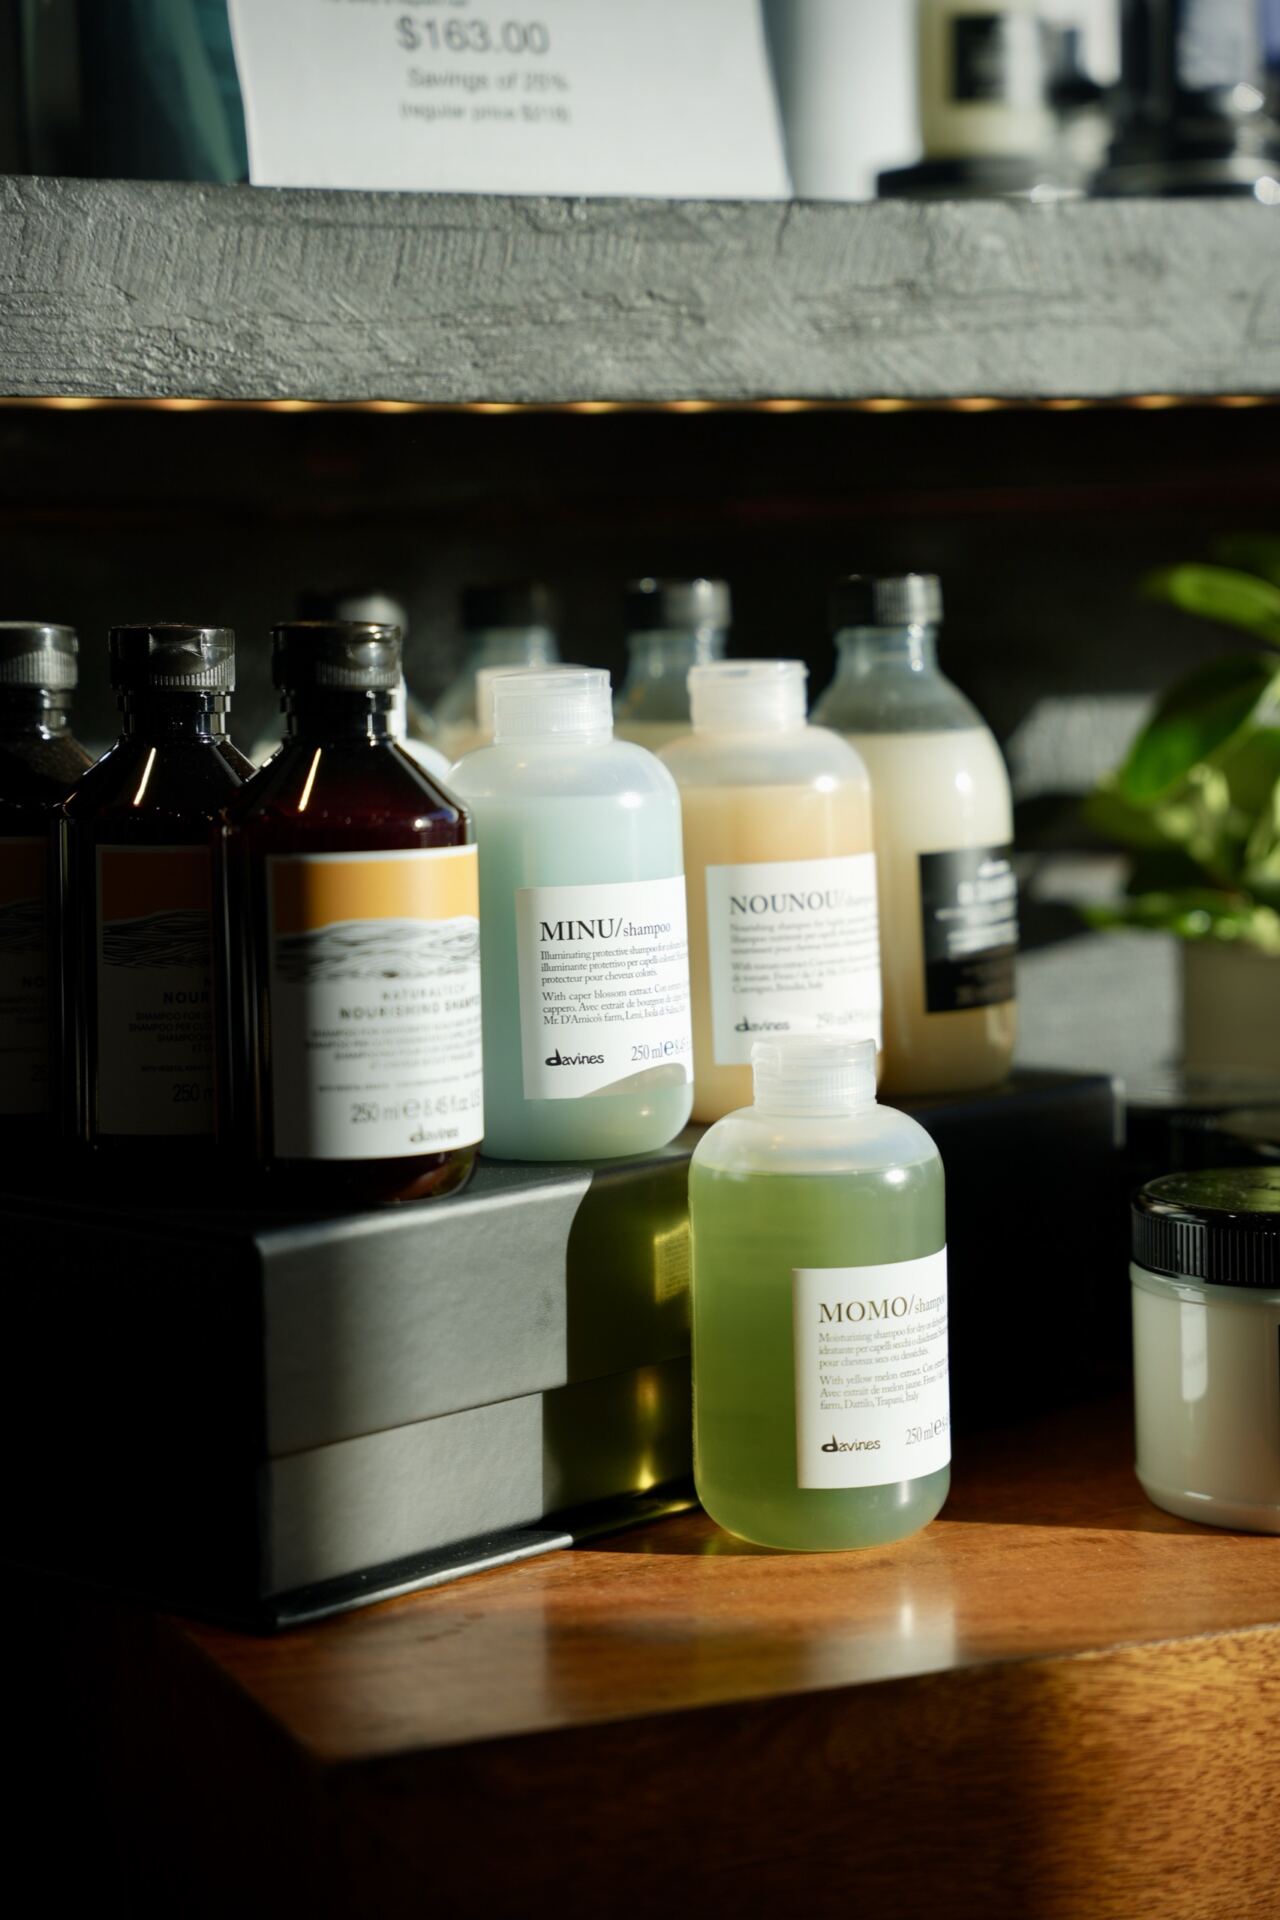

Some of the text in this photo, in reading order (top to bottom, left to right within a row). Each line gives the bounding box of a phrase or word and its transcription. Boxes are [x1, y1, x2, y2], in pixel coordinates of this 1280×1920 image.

[395, 15, 551, 54] $163.00
[407, 66, 489, 95] Savings
[496, 71, 518, 89] of
[540, 951, 591, 960] Illuminating
[592, 949, 628, 959] protective
[629, 946, 657, 956] shampoo
[541, 963, 587, 972] illuminante
[589, 961, 625, 972] protettivo
[627, 960, 638, 968] per
[542, 976, 582, 986] protecteur
[585, 975, 603, 984] pour
[604, 972, 633, 981] cheveux
[542, 991, 566, 1000] With
[569, 992, 591, 1002] caper
[594, 990, 626, 999] blossom
[339, 1004, 440, 1019] NOURISHING
[543, 1006, 576, 1016] cappero.
[579, 1003, 598, 1012] Avec
[601, 1000, 625, 1010] extrait
[626, 999, 635, 1008] de
[544, 1016, 559, 1025] Mr.
[604, 1012, 625, 1022] farm,
[545, 1048, 604, 1066] davines
[630, 1045, 650, 1061] 250
[172, 1083, 200, 1102] 250
[350, 1102, 380, 1124] 250
[873, 1328, 905, 1340] shampoo
[856, 1345, 868, 1356] per
[819, 1358, 839, 1370] pour
[841, 1357, 872, 1367] cheveux
[819, 1375, 844, 1385] With
[846, 1374, 872, 1388] yellow
[874, 1371, 898, 1382] melon
[820, 1387, 842, 1398] Avec
[843, 1387, 868, 1397] extrait
[871, 1385, 879, 1394] de
[881, 1383, 904, 1394] melon
[820, 1400, 843, 1411] farm,
[821, 1434, 881, 1453] davines
[905, 1427, 923, 1445] 250
